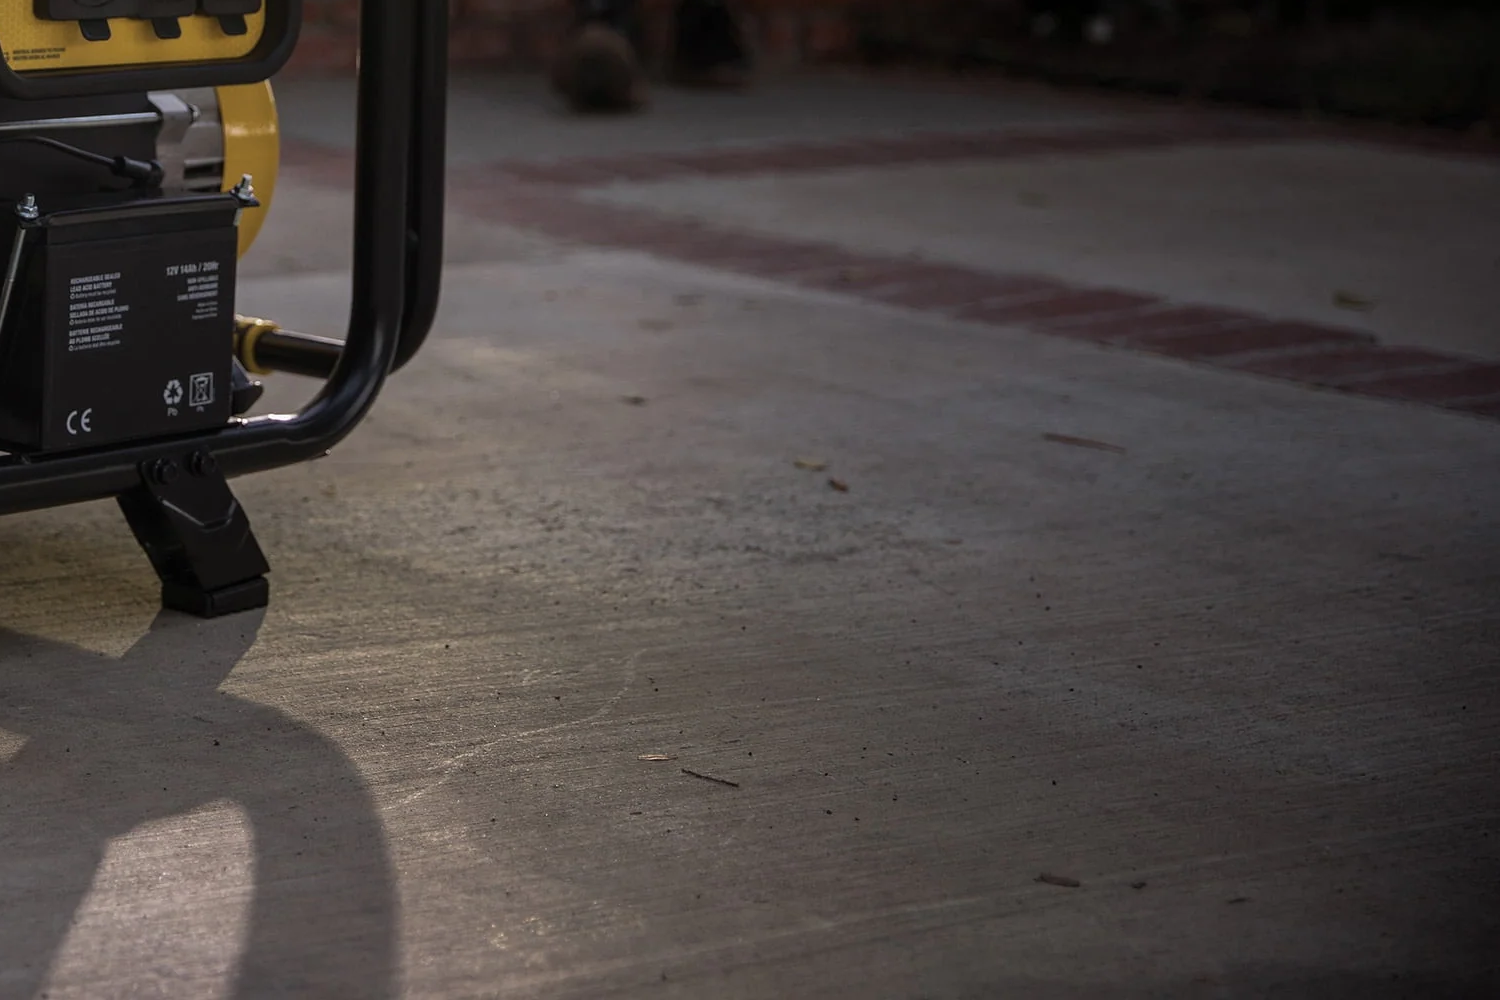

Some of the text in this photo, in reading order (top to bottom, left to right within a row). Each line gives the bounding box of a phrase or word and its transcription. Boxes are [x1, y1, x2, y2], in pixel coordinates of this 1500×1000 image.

[166, 266, 179, 277] 12V
[166, 407, 178, 417] Pb
[66, 407, 92, 436] CE
